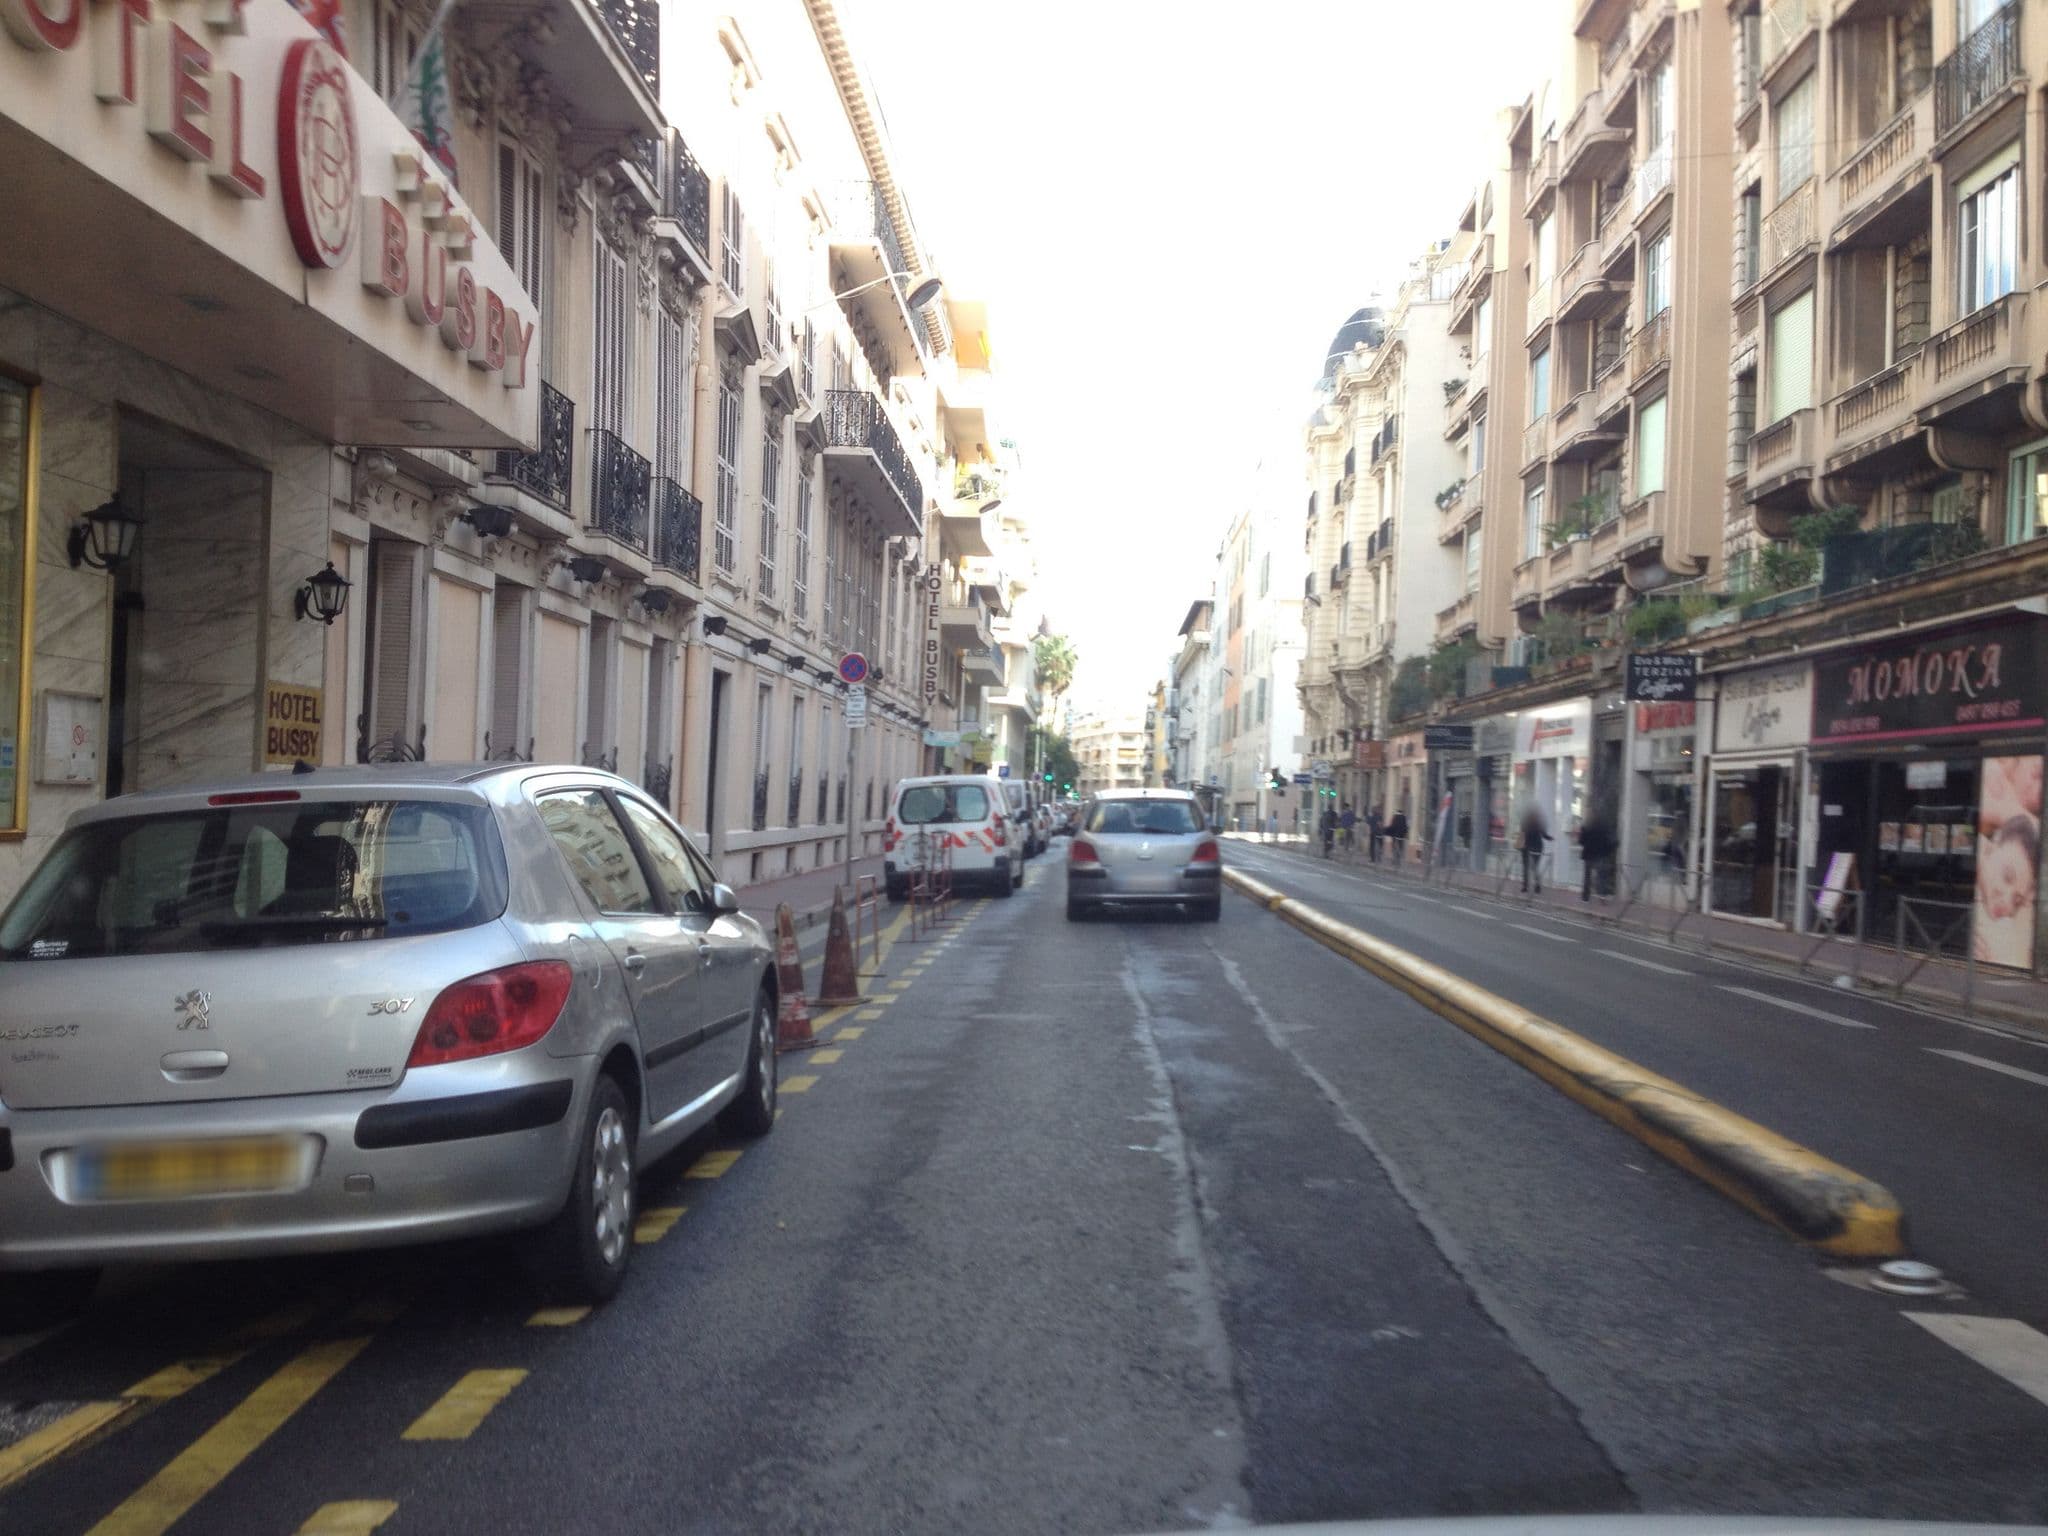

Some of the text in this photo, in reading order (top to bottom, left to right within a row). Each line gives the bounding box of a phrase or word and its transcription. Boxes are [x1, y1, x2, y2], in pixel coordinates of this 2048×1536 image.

[14, 0, 266, 200] TEL
[368, 197, 536, 389] BUSBY
[924, 564, 941, 706] HOTEL BUSBY
[1634, 666, 1692, 677] TERZIAN
[1846, 643, 2002, 705] MOMOKA
[269, 690, 320, 724] HOTEL
[267, 727, 320, 758] BUSBY
[366, 996, 416, 1016] 307
